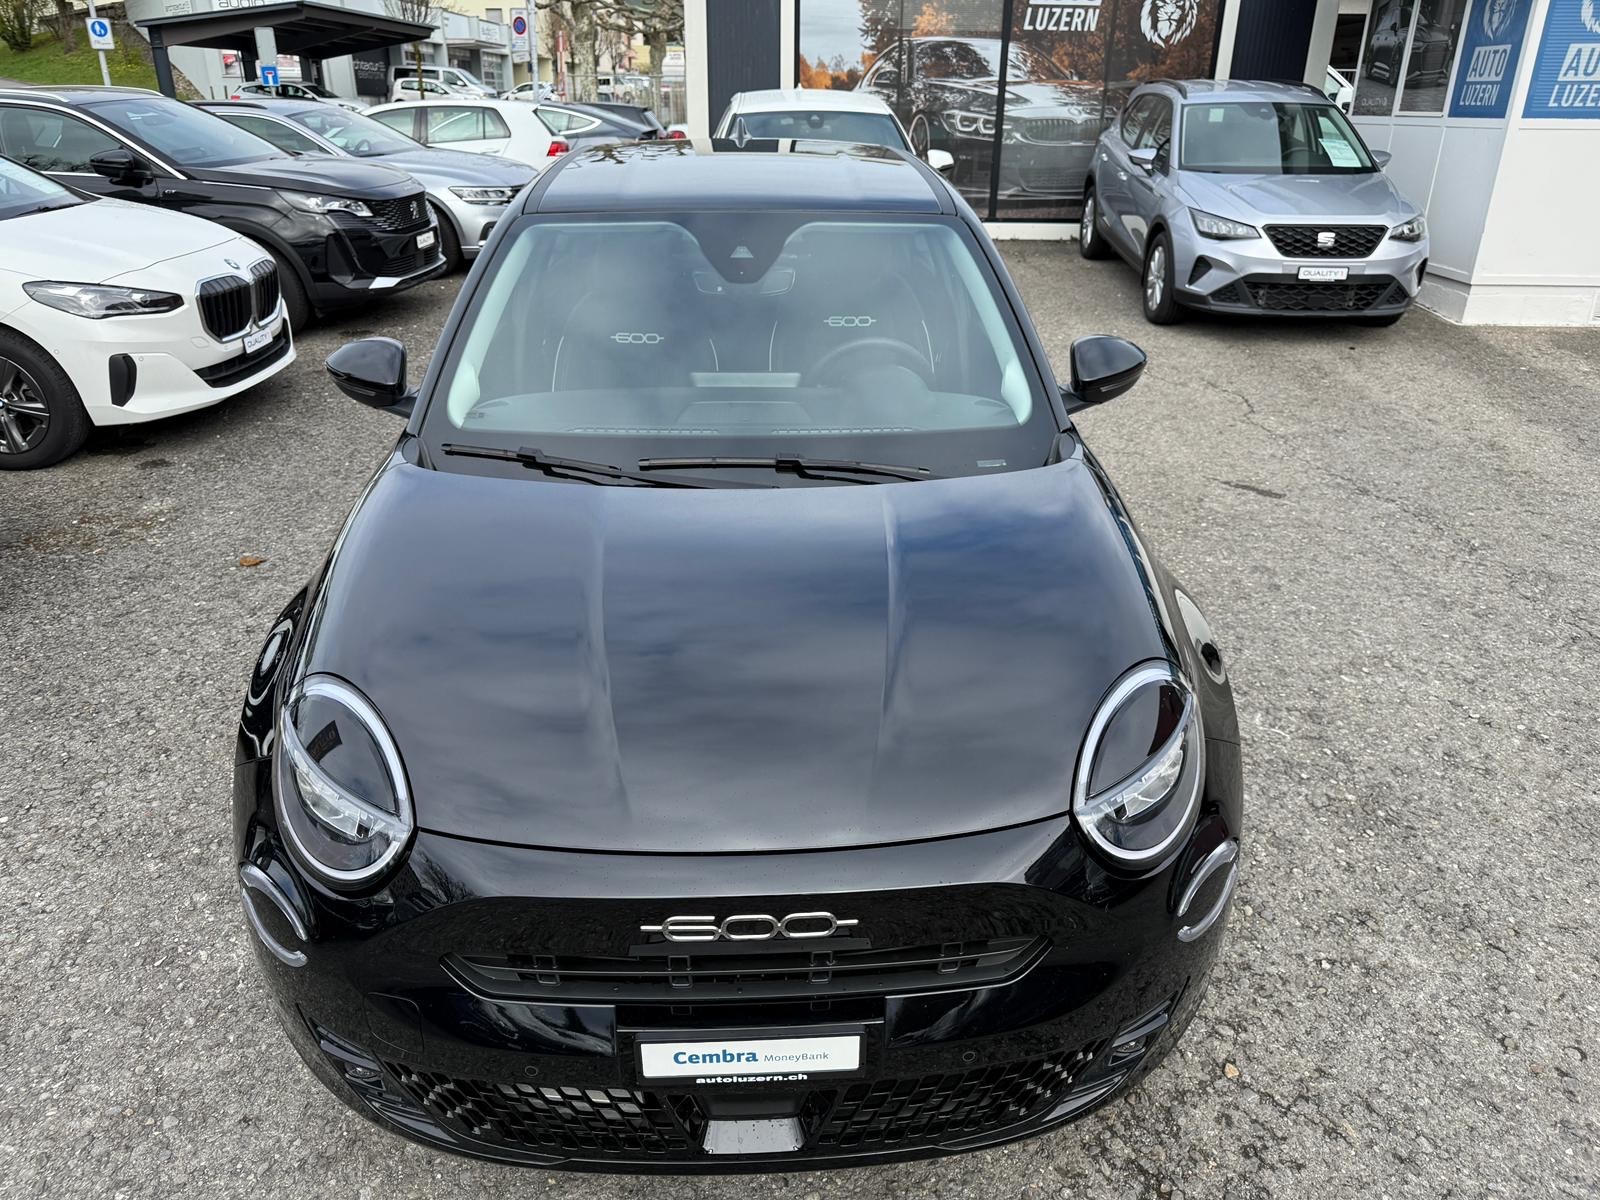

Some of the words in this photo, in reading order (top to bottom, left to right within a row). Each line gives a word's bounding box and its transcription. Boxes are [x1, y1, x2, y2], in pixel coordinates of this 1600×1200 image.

[1023, 7, 1100, 32] LUZERN
[1468, 47, 1508, 79] AUTO
[1459, 84, 1500, 106] LUZERN
[1548, 84, 1600, 107] LUZE
[823, 316, 877, 326] 600
[610, 332, 664, 343] 600
[641, 911, 858, 942] 600
[673, 1049, 759, 1065] Cembra
[763, 1051, 829, 1062] MoneyBank
[695, 1073, 808, 1084] autoluzern.ch
